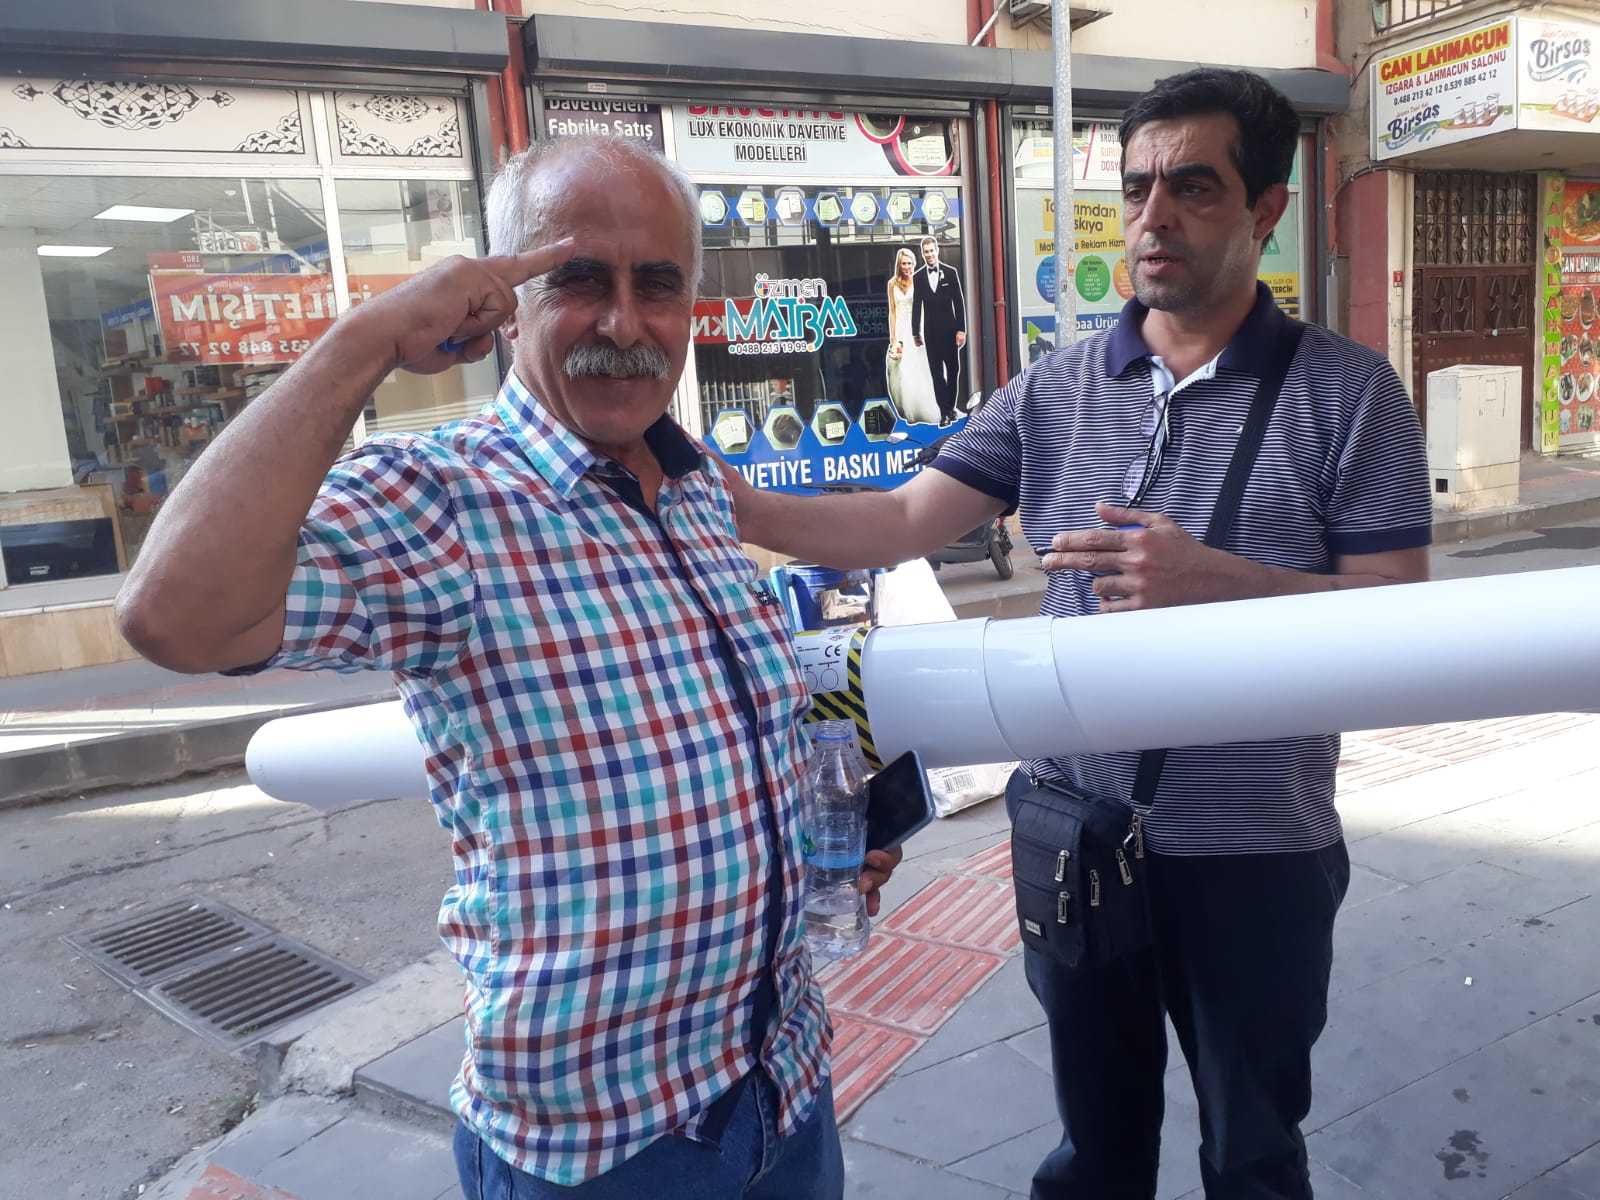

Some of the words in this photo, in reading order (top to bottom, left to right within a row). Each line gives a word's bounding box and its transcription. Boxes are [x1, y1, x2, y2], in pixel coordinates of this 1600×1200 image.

[1381, 56, 1412, 81] CAN
[1416, 25, 1508, 70] LAHMACUN
[1386, 78, 1414, 96] IZGARA
[1424, 63, 1469, 84] LAHMACUN
[1471, 50, 1506, 70] SALONU
[1411, 90, 1424, 101] 213
[1435, 85, 1443, 94] 12
[1488, 69, 1497, 79] 12
[548, 119, 610, 136] Fabrika
[613, 120, 654, 140] Satış
[688, 117, 715, 137] LÜX
[719, 119, 785, 139] EKONOMİK
[788, 122, 847, 140] DAVETİYE
[735, 143, 806, 161] MODELLERİ
[1081, 239, 1107, 250] Reklam
[1108, 238, 1126, 248] Hizm
[1576, 256, 1600, 272] LAHMA
[1095, 315, 1119, 329] Ürün
[736, 343, 761, 354] 0488
[761, 342, 780, 353] 213
[782, 341, 794, 352] 19
[794, 341, 808, 352] 99
[733, 456, 812, 488] VETİYE
[823, 452, 880, 482] BASKI
